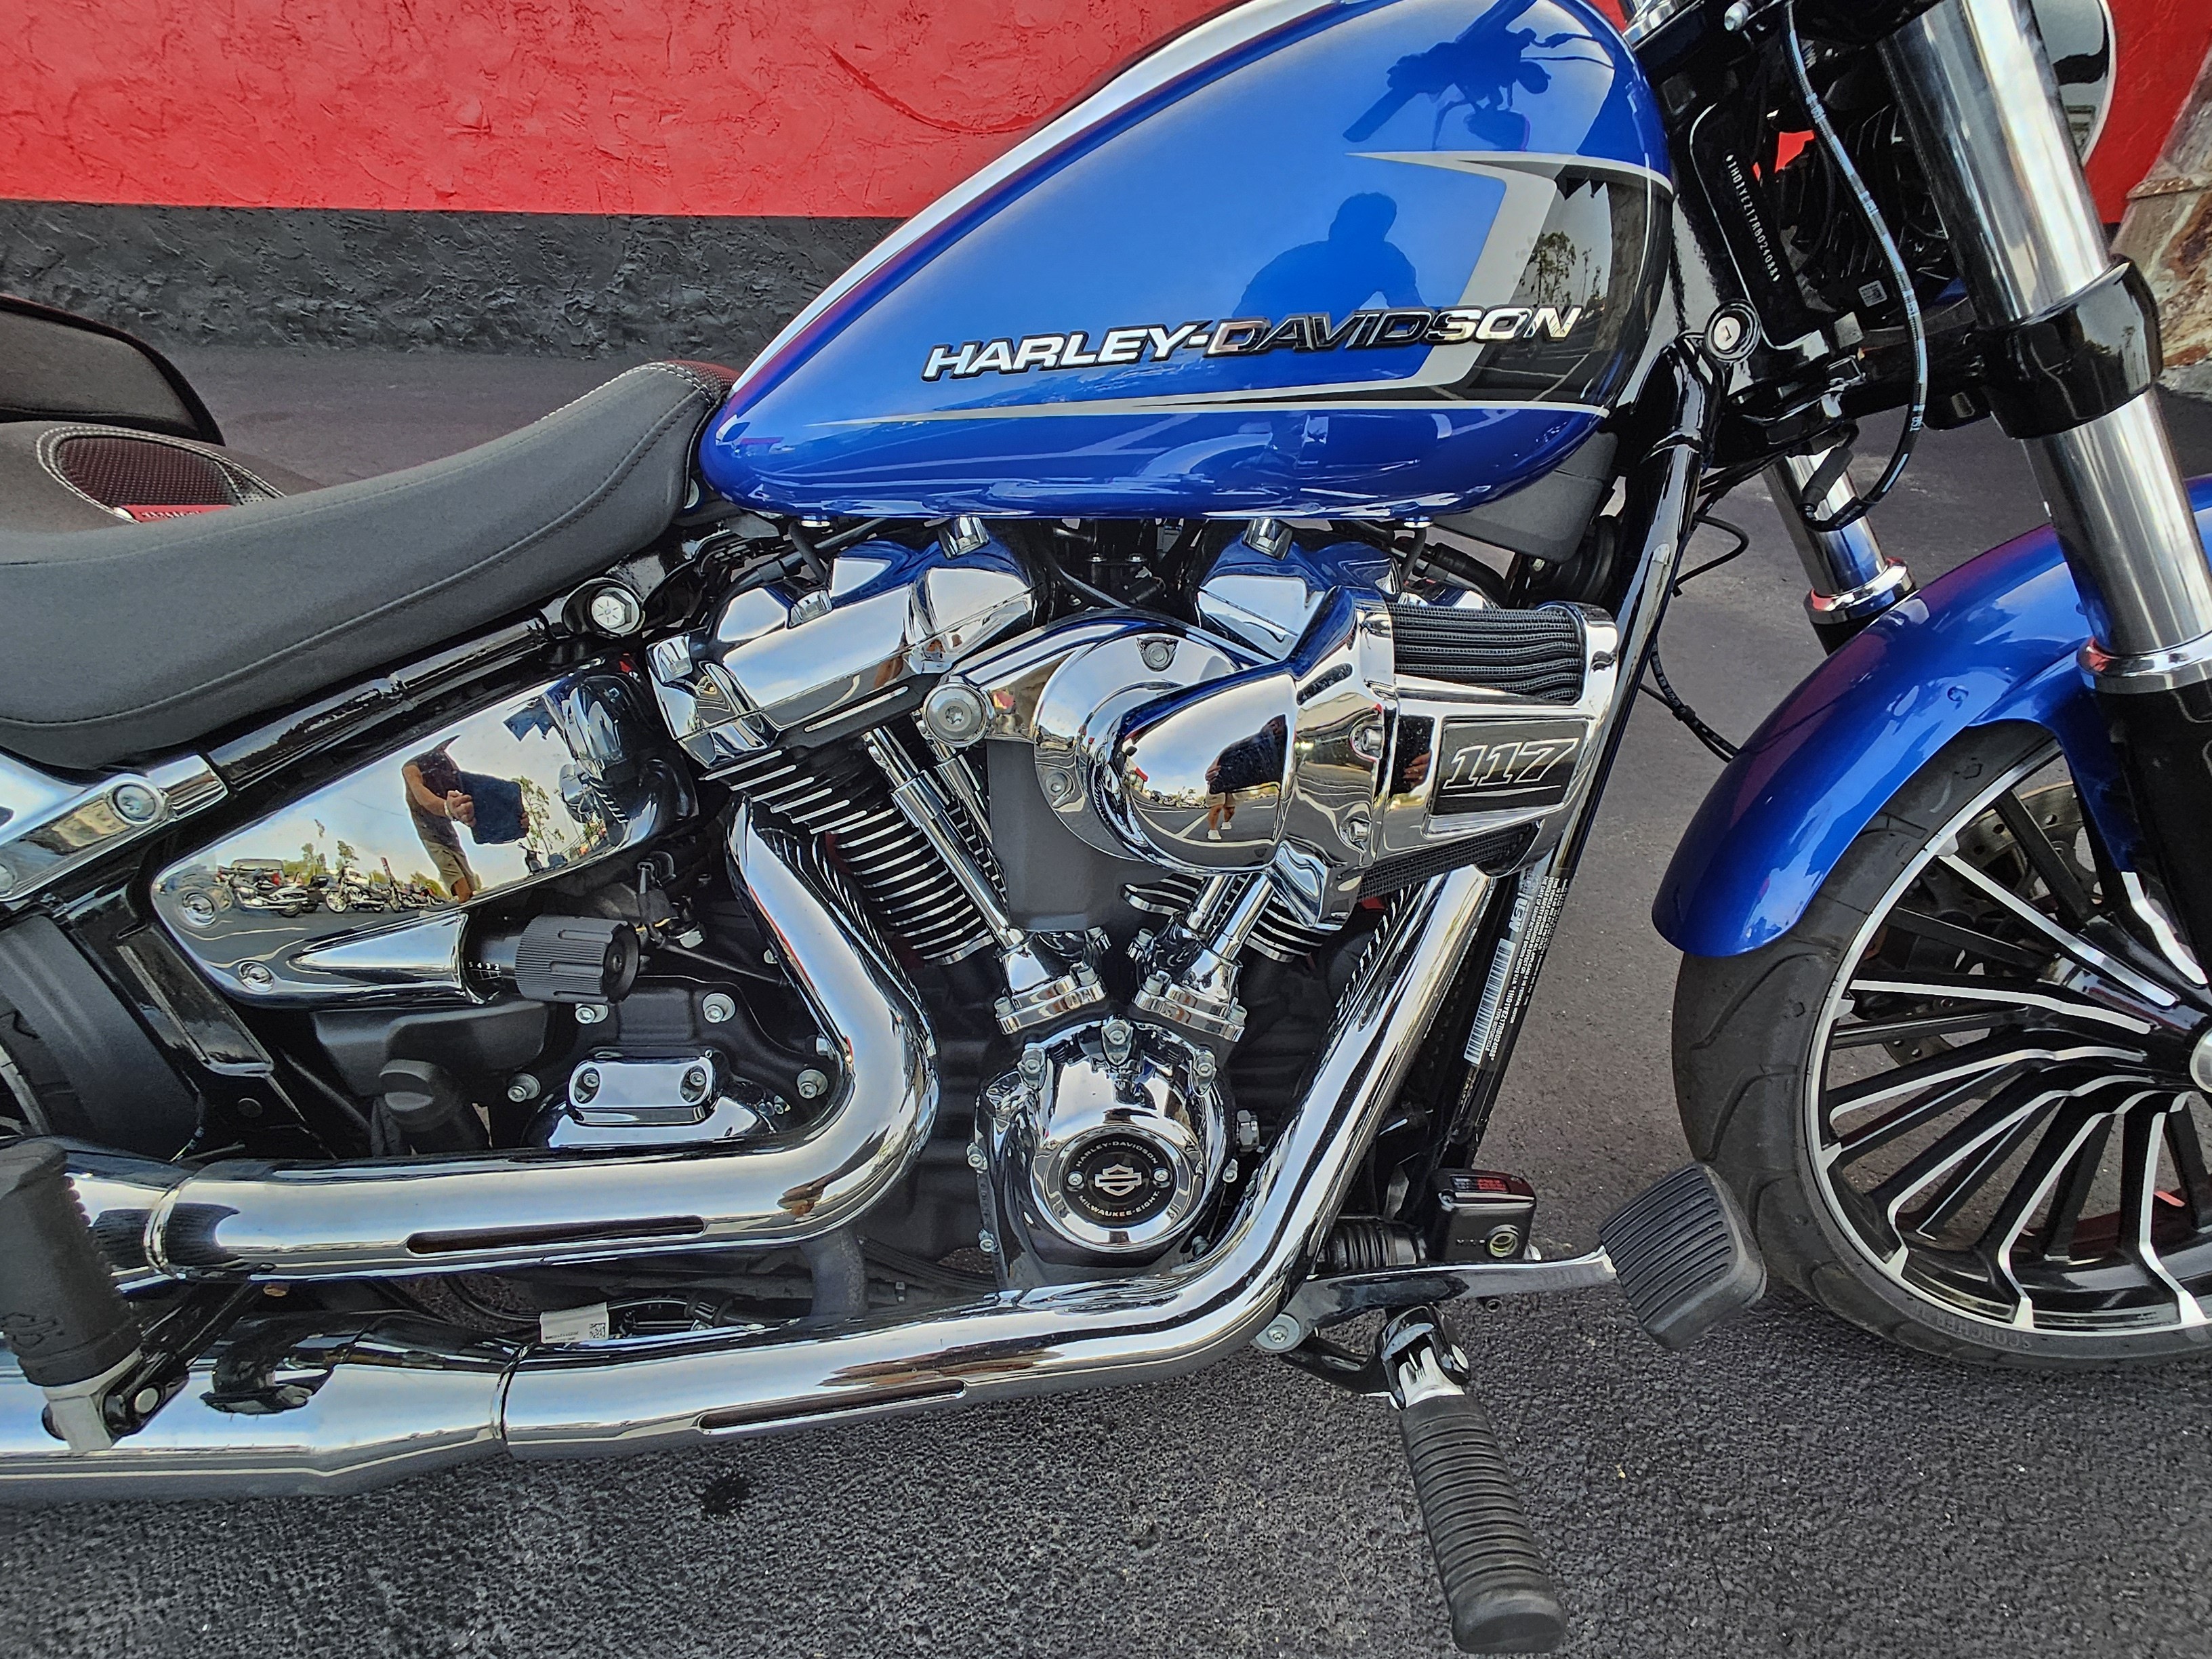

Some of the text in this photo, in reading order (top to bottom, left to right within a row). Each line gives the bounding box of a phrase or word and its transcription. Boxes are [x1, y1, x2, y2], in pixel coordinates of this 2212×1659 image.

[922, 306, 1584, 382] HARLEY-DAVIDSON
[1443, 737, 1579, 790] 117
[1509, 897, 1528, 933] USW
[1076, 1141, 1159, 1168] HARLEY-DAVIDSON
